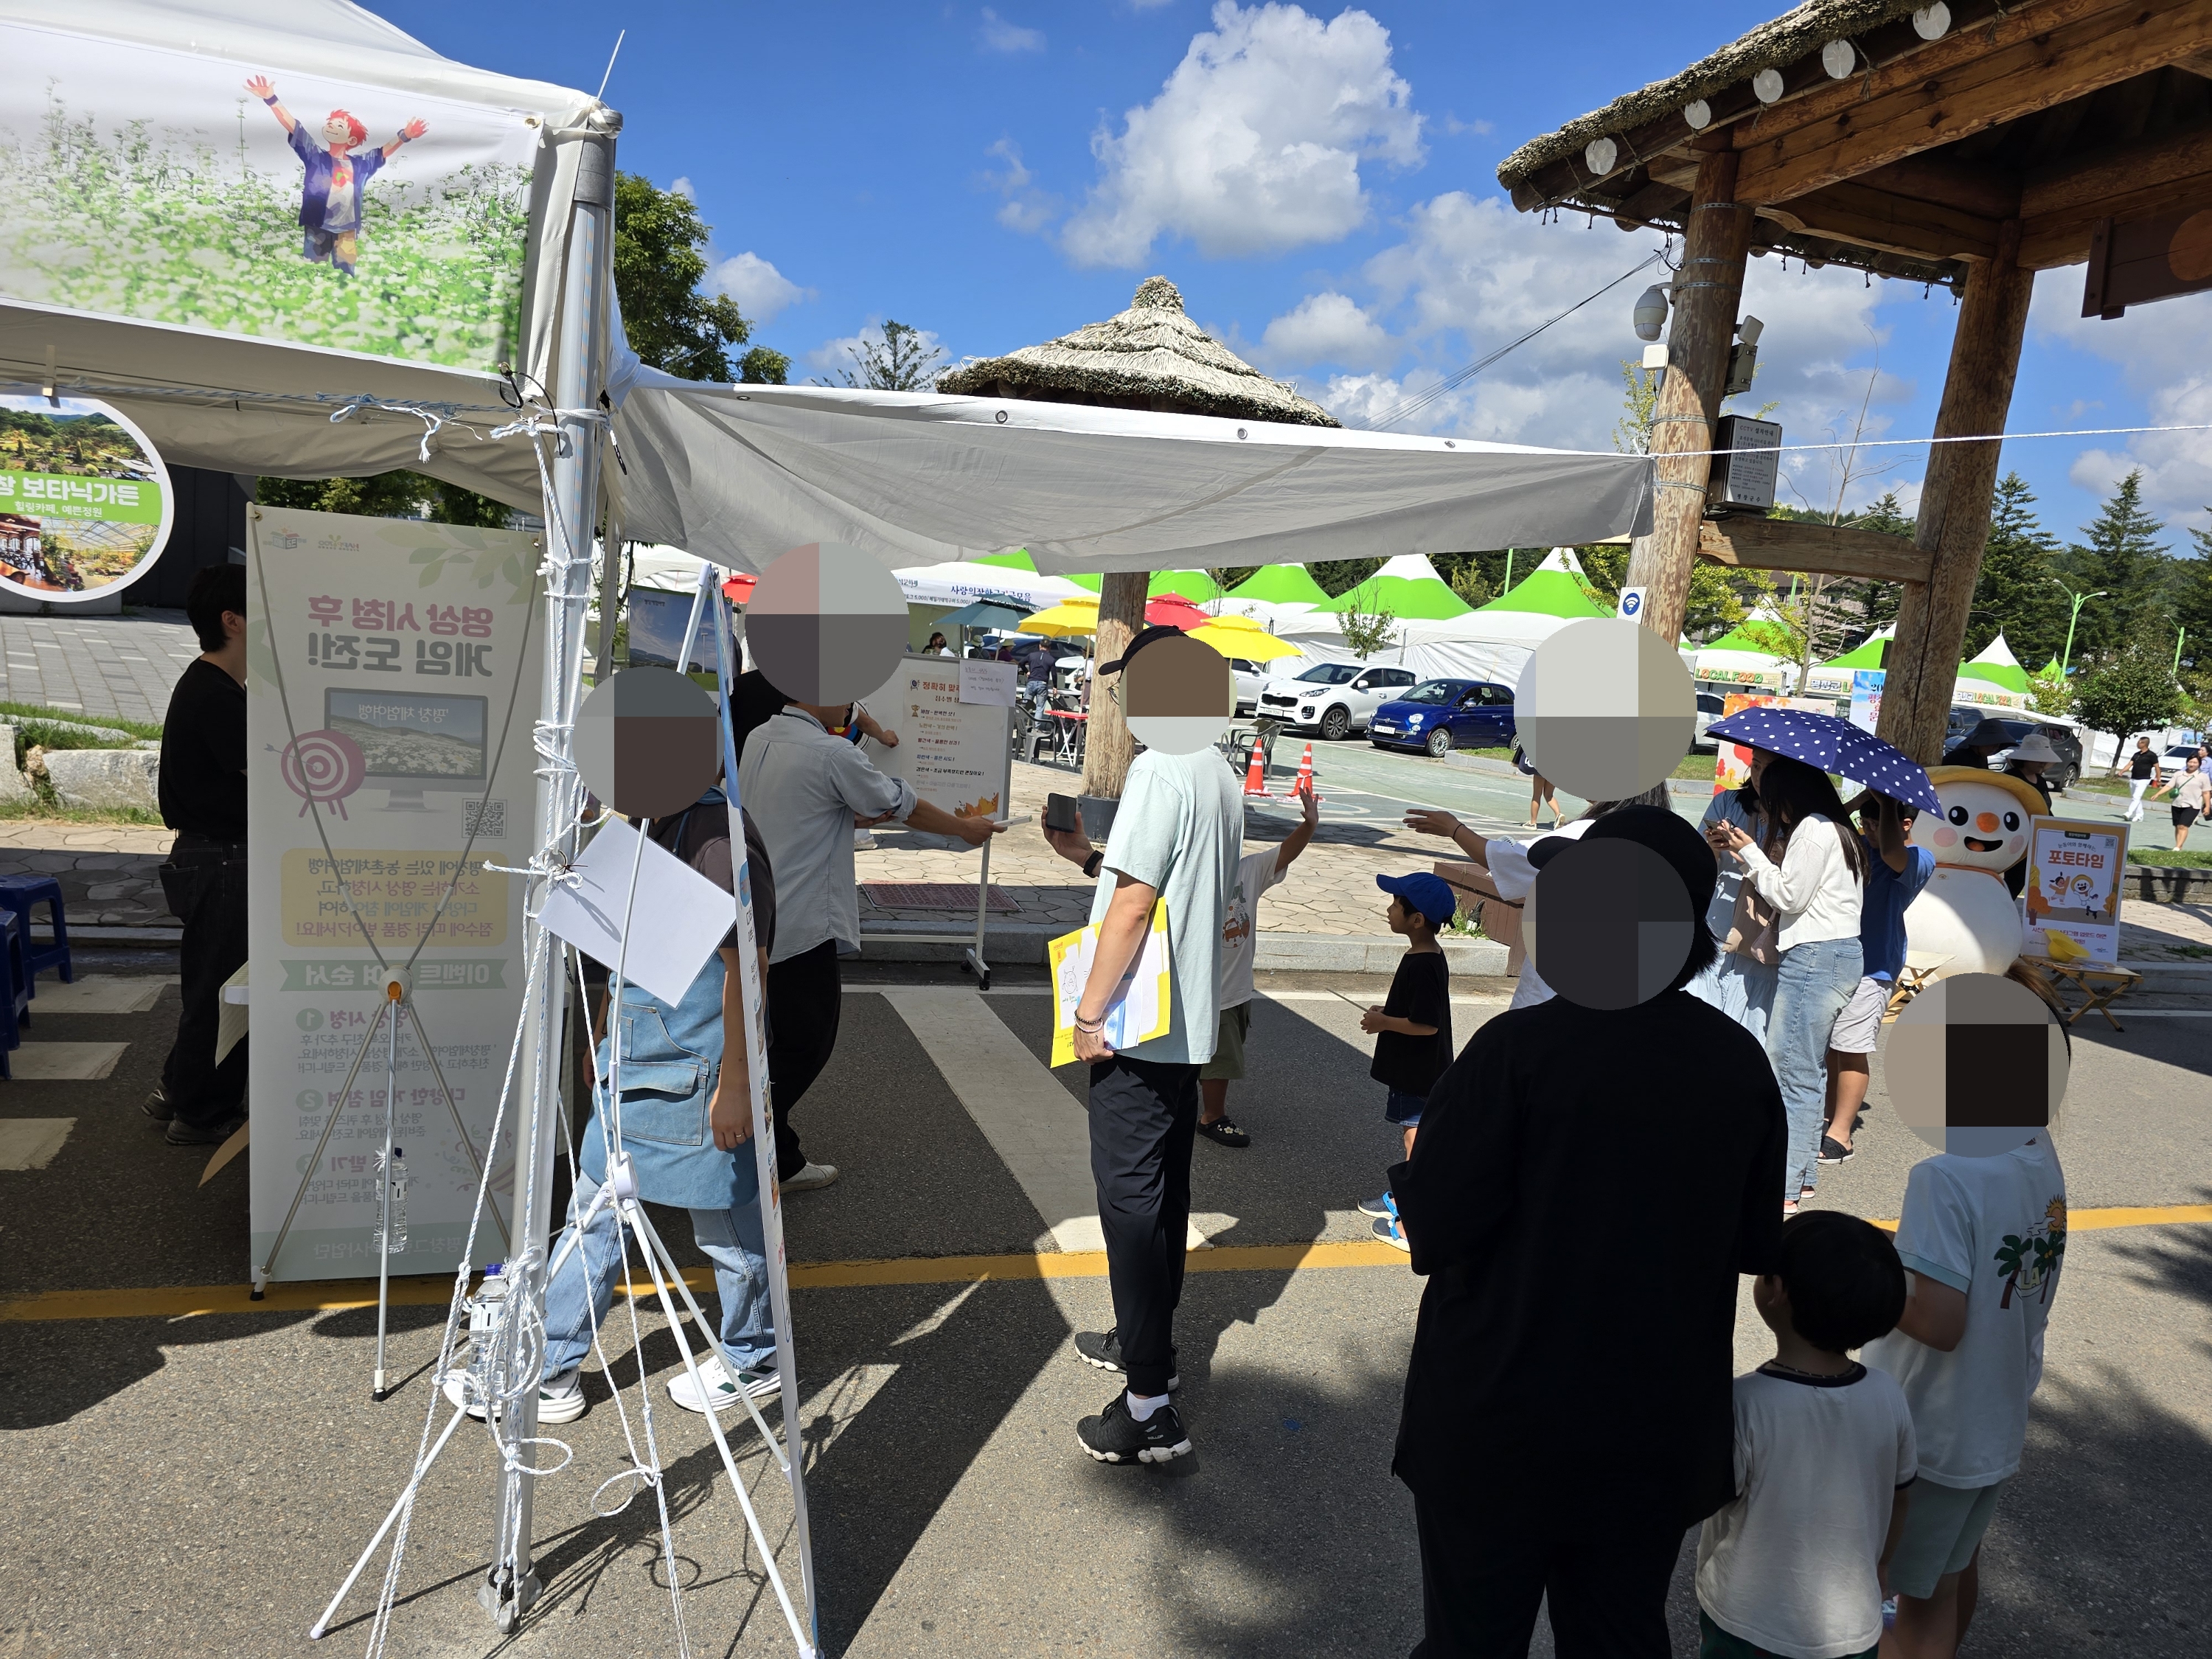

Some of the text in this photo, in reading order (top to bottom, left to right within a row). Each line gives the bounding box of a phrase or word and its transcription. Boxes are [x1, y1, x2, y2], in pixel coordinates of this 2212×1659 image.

[1756, 428, 1773, 437] 설치안내
[23, 478, 139, 506] 보타닉가든
[15, 501, 102, 517] 힐링카페, 예쁜정원
[1695, 668, 1730, 681] LOCAL
[1732, 672, 1764, 684] FOOD
[922, 681, 946, 692] 정확히
[1810, 679, 1841, 692] 평창군
[2048, 850, 2105, 869] 포토타임
[2020, 1266, 2041, 1290] LA
